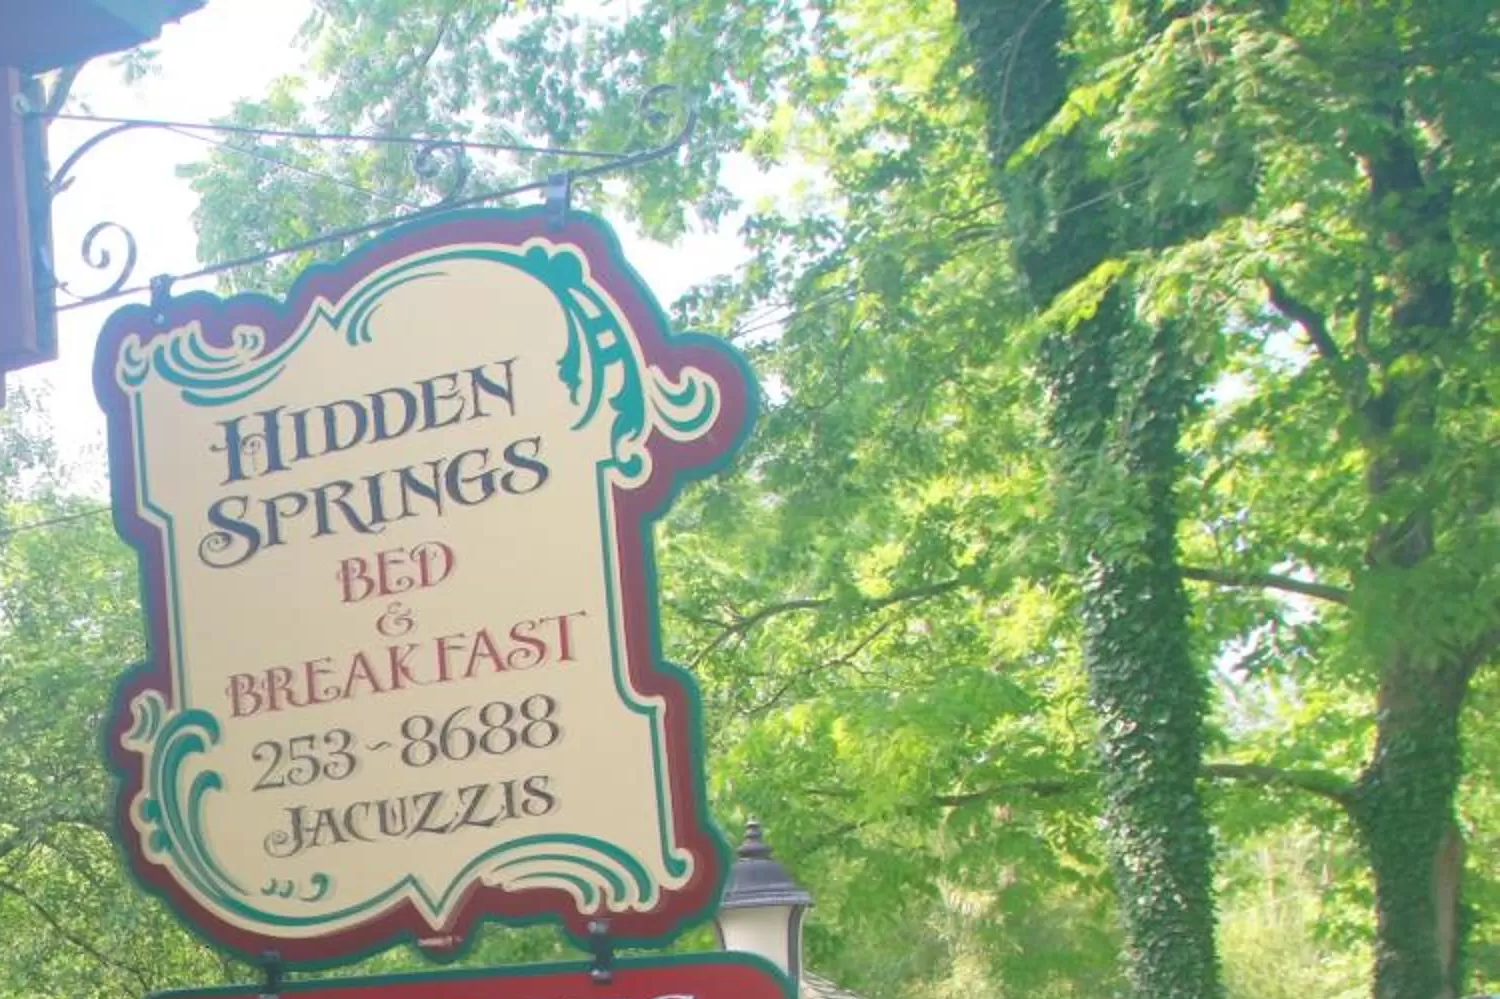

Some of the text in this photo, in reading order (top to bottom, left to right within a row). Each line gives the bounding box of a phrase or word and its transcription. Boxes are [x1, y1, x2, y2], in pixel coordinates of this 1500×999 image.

[209, 357, 520, 487] HIDDEN
[198, 436, 551, 569] SPRINGS
[335, 540, 457, 604] BED
[375, 600, 416, 638] &
[225, 609, 589, 720] BREAKFAST
[262, 774, 558, 858] JACUZZIS
